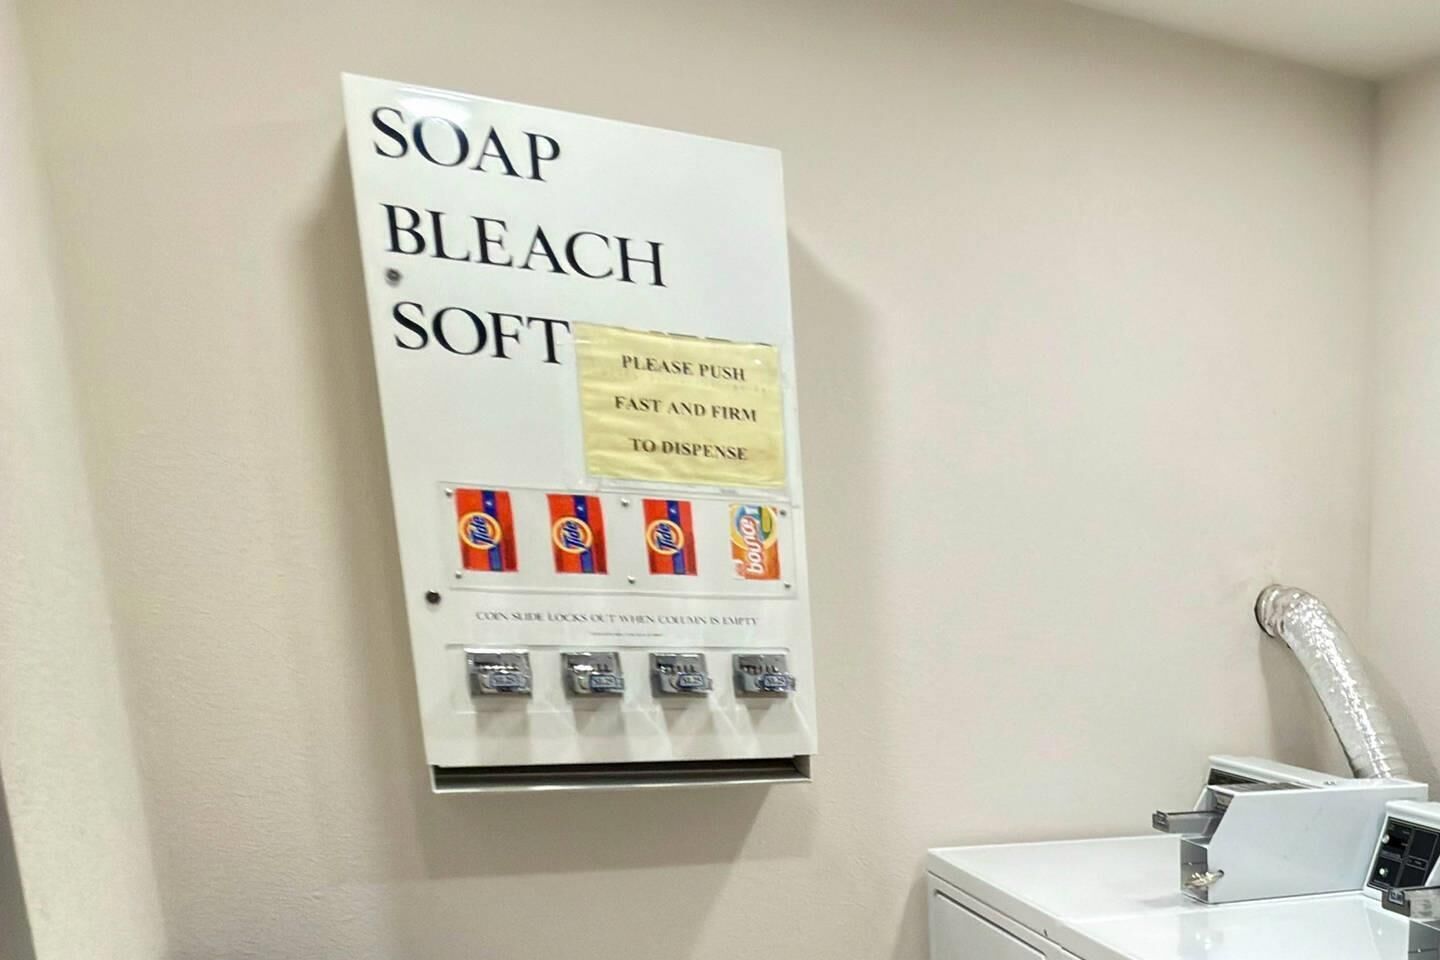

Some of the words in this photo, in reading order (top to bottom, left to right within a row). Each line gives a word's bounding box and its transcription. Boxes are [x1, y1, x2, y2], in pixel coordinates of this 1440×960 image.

[371, 107, 561, 182] SOAP
[382, 203, 667, 287] BLEACH
[392, 301, 570, 364] SOFT
[622, 355, 694, 375] PLEASE
[700, 363, 746, 381] PUSH
[614, 396, 661, 412] FAST
[668, 402, 706, 416] AND
[712, 405, 757, 422] FIRM
[629, 438, 657, 452] TO
[661, 440, 748, 460] DISPENSE
[469, 514, 497, 547] Tide
[562, 520, 590, 551] Tide
[656, 522, 680, 553] Tide
[547, 612, 588, 623] LOCKS
[619, 615, 655, 625] WHEN
[722, 616, 758, 626] EMPTY
